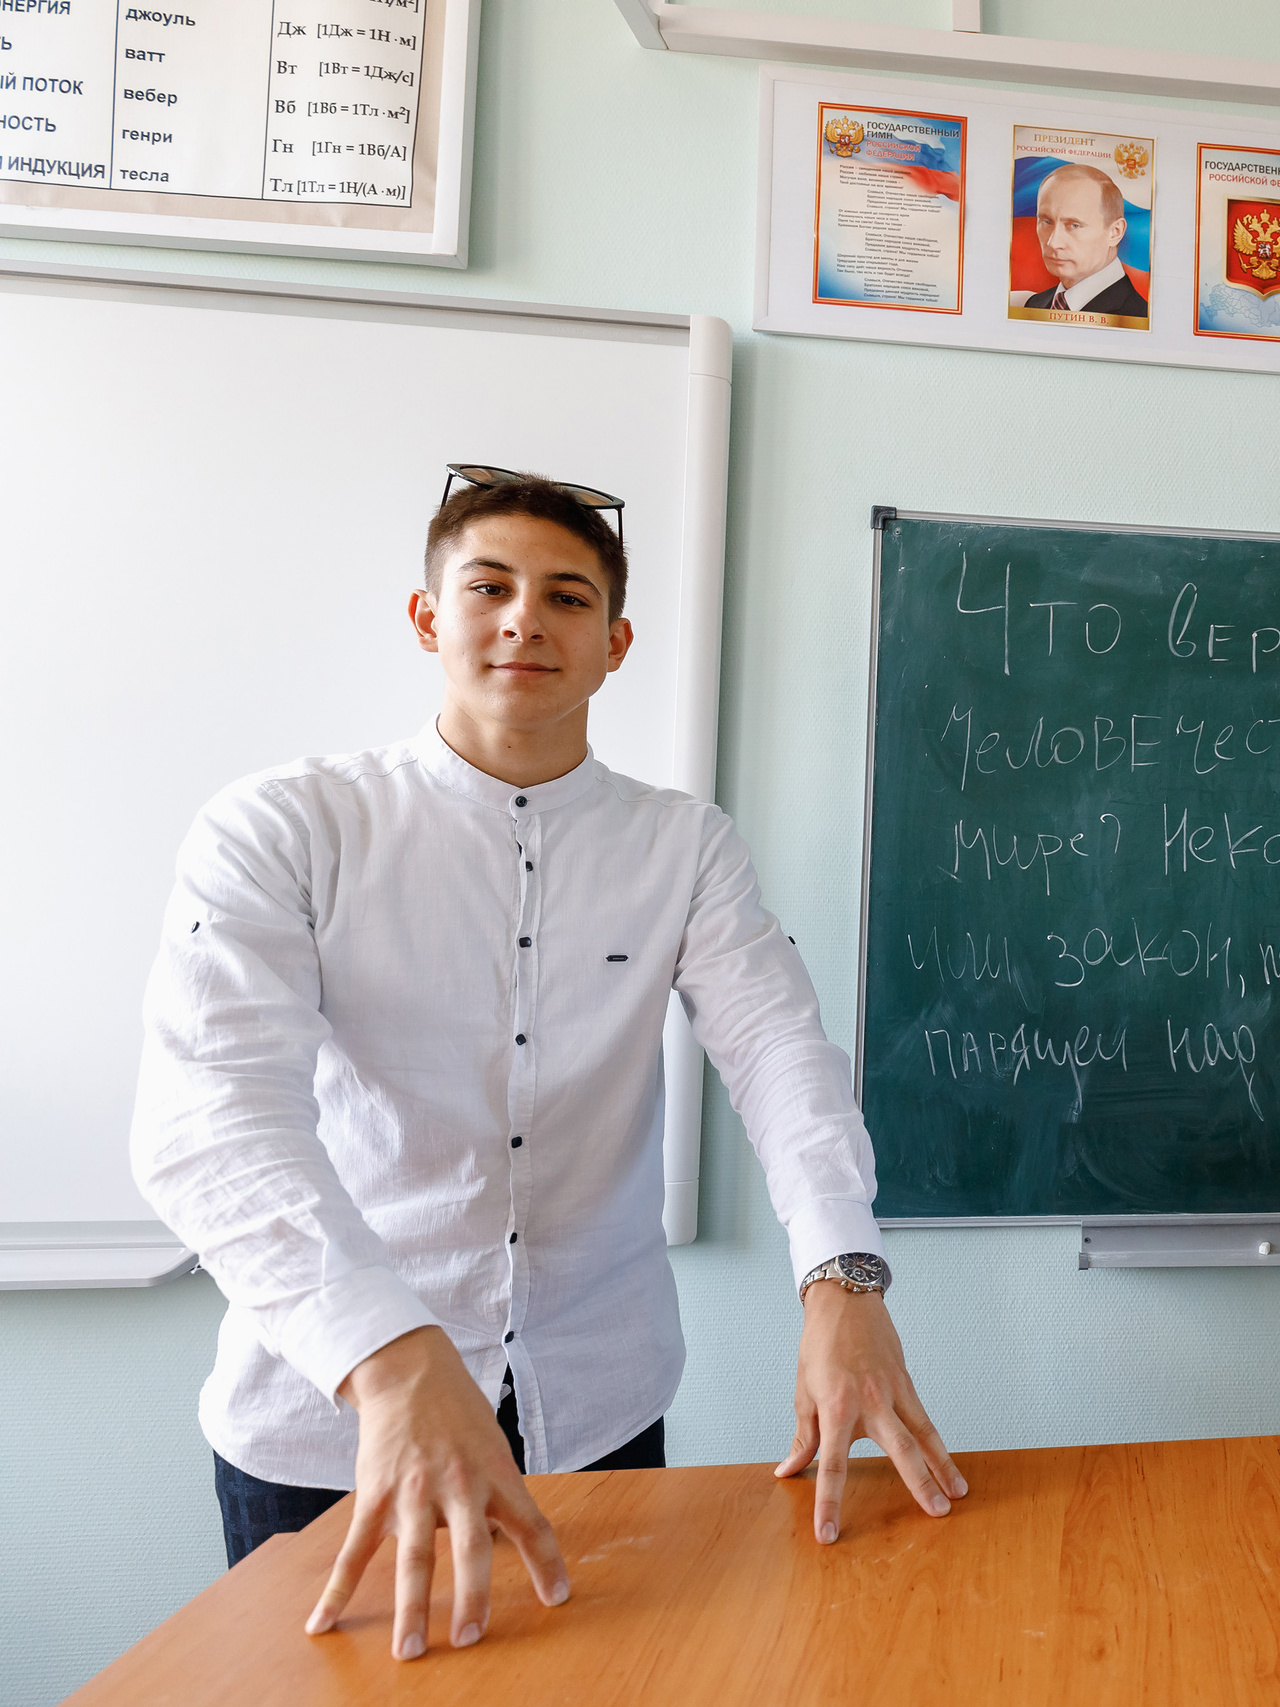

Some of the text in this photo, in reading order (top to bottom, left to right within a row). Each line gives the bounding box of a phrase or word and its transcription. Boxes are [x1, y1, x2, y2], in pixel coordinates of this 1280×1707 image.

[0, 0, 71, 15] НЕРГИЯ
[125, 8, 196, 27] джоуль
[277, 21, 307, 39] Дж
[125, 48, 166, 63] ватт
[276, 60, 298, 75] Вт
[22, 76, 84, 96] ПОТОК
[123, 88, 178, 107] вебер
[274, 99, 296, 114] Вб
[121, 128, 173, 146] генри
[866, 121, 960, 138] ГОСУДАРСТВЕННЫЙ
[866, 130, 893, 140] ГИМН
[271, 138, 294, 154] Гн
[866, 140, 921, 152] РОССИЙСКОЙ
[1033, 133, 1096, 147] ПРЕЗИДЕНТ
[865, 150, 915, 161] ФЕДЕРАЦИИ
[1016, 144, 1112, 159] РОССИЙСКОЙ ФЕДЕРАЦИИ
[8, 156, 106, 180] ИНДУКЦИЯ
[119, 168, 170, 183] тесла
[269, 177, 293, 193] Тл
[1208, 173, 1268, 186] РОССИЙСКОЙ
[1049, 312, 1110, 325] ПУТИН В. В.
[955, 551, 1123, 676] Что
[1166, 1016, 1264, 1121] над
